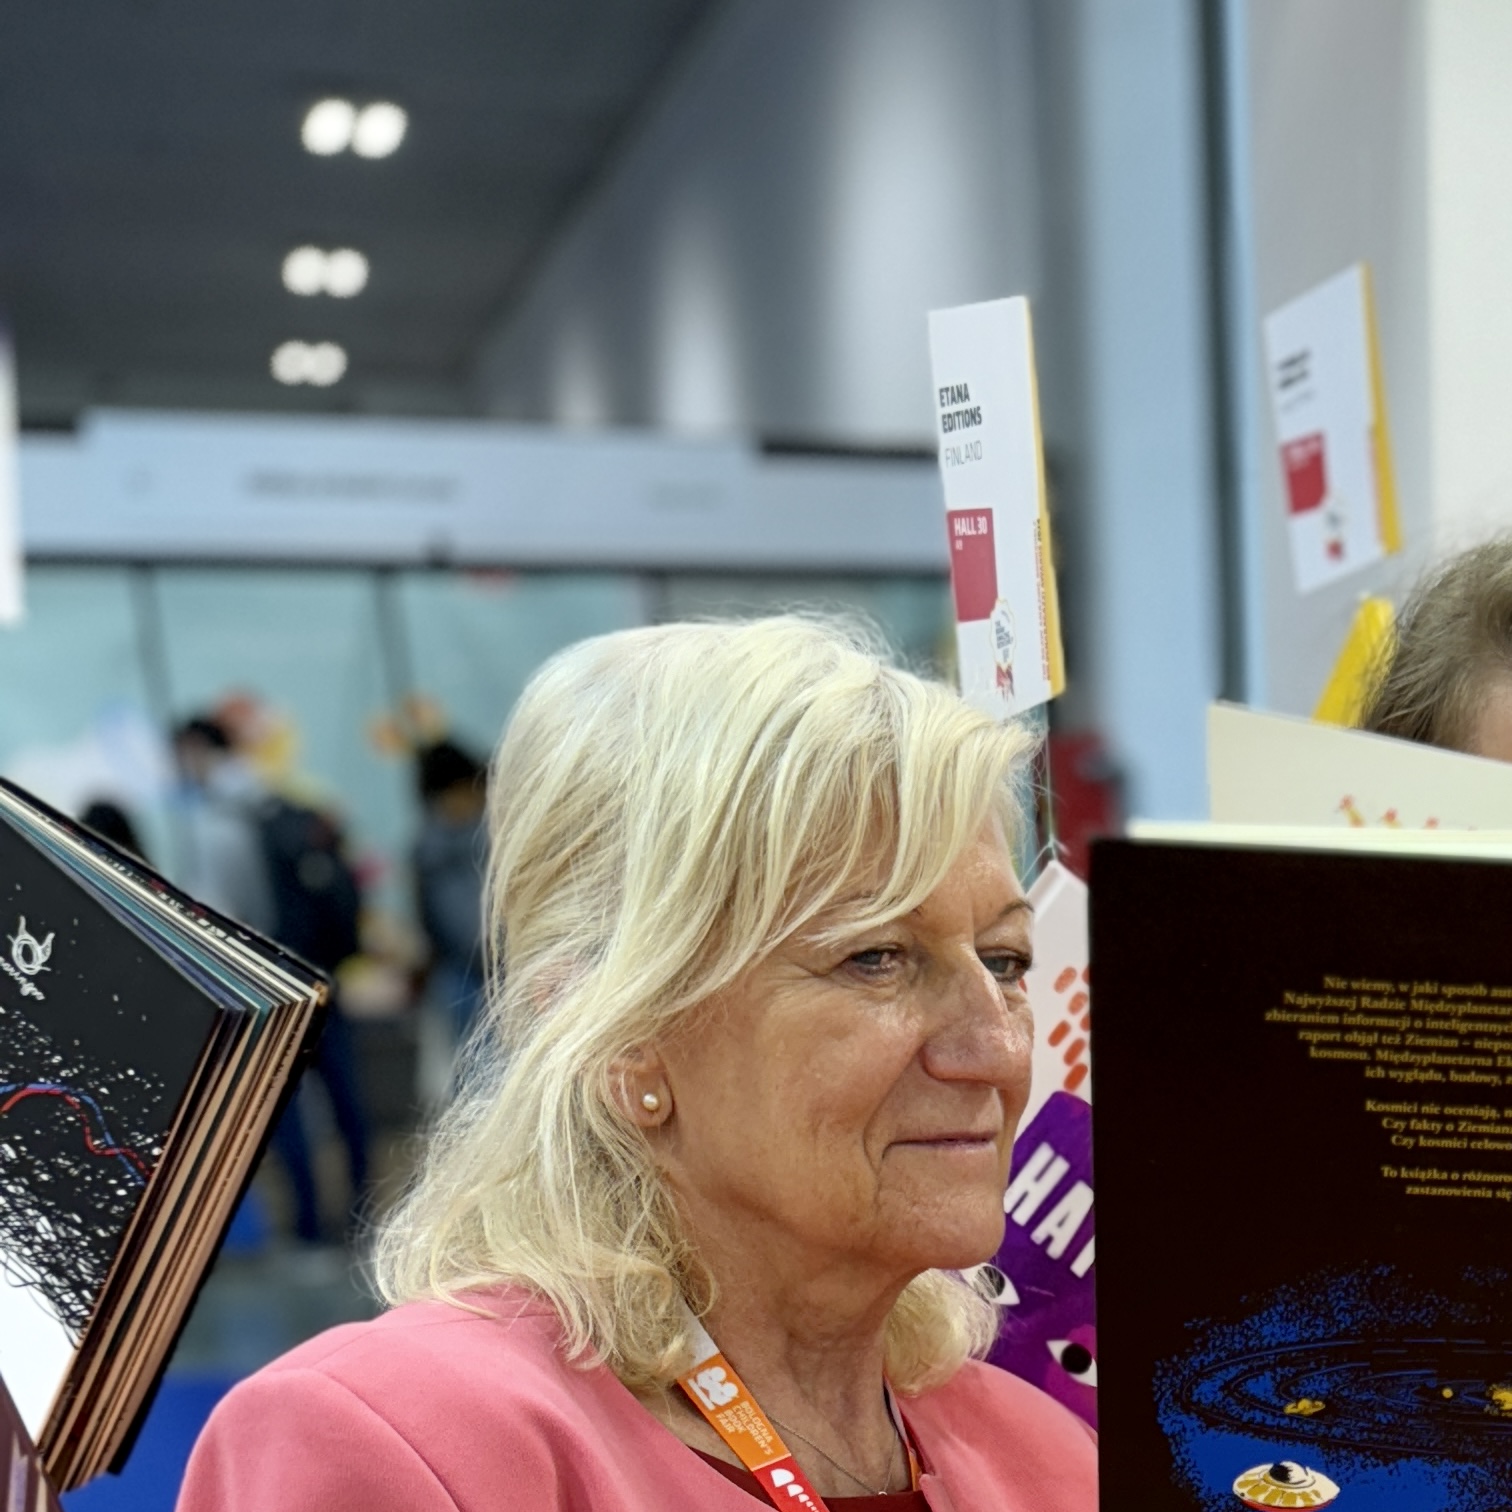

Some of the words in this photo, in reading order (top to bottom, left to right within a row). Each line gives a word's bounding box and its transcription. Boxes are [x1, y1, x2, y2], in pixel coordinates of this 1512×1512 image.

[939, 383, 970, 408] ETANA
[941, 406, 982, 433] EDITIONS
[945, 440, 983, 468] FINLAND
[954, 516, 976, 536] HALL
[977, 516, 988, 535] 30
[715, 1412, 735, 1433] FAIR
[723, 1408, 746, 1434] BOOK
[739, 1399, 773, 1443] BOLOGNA
